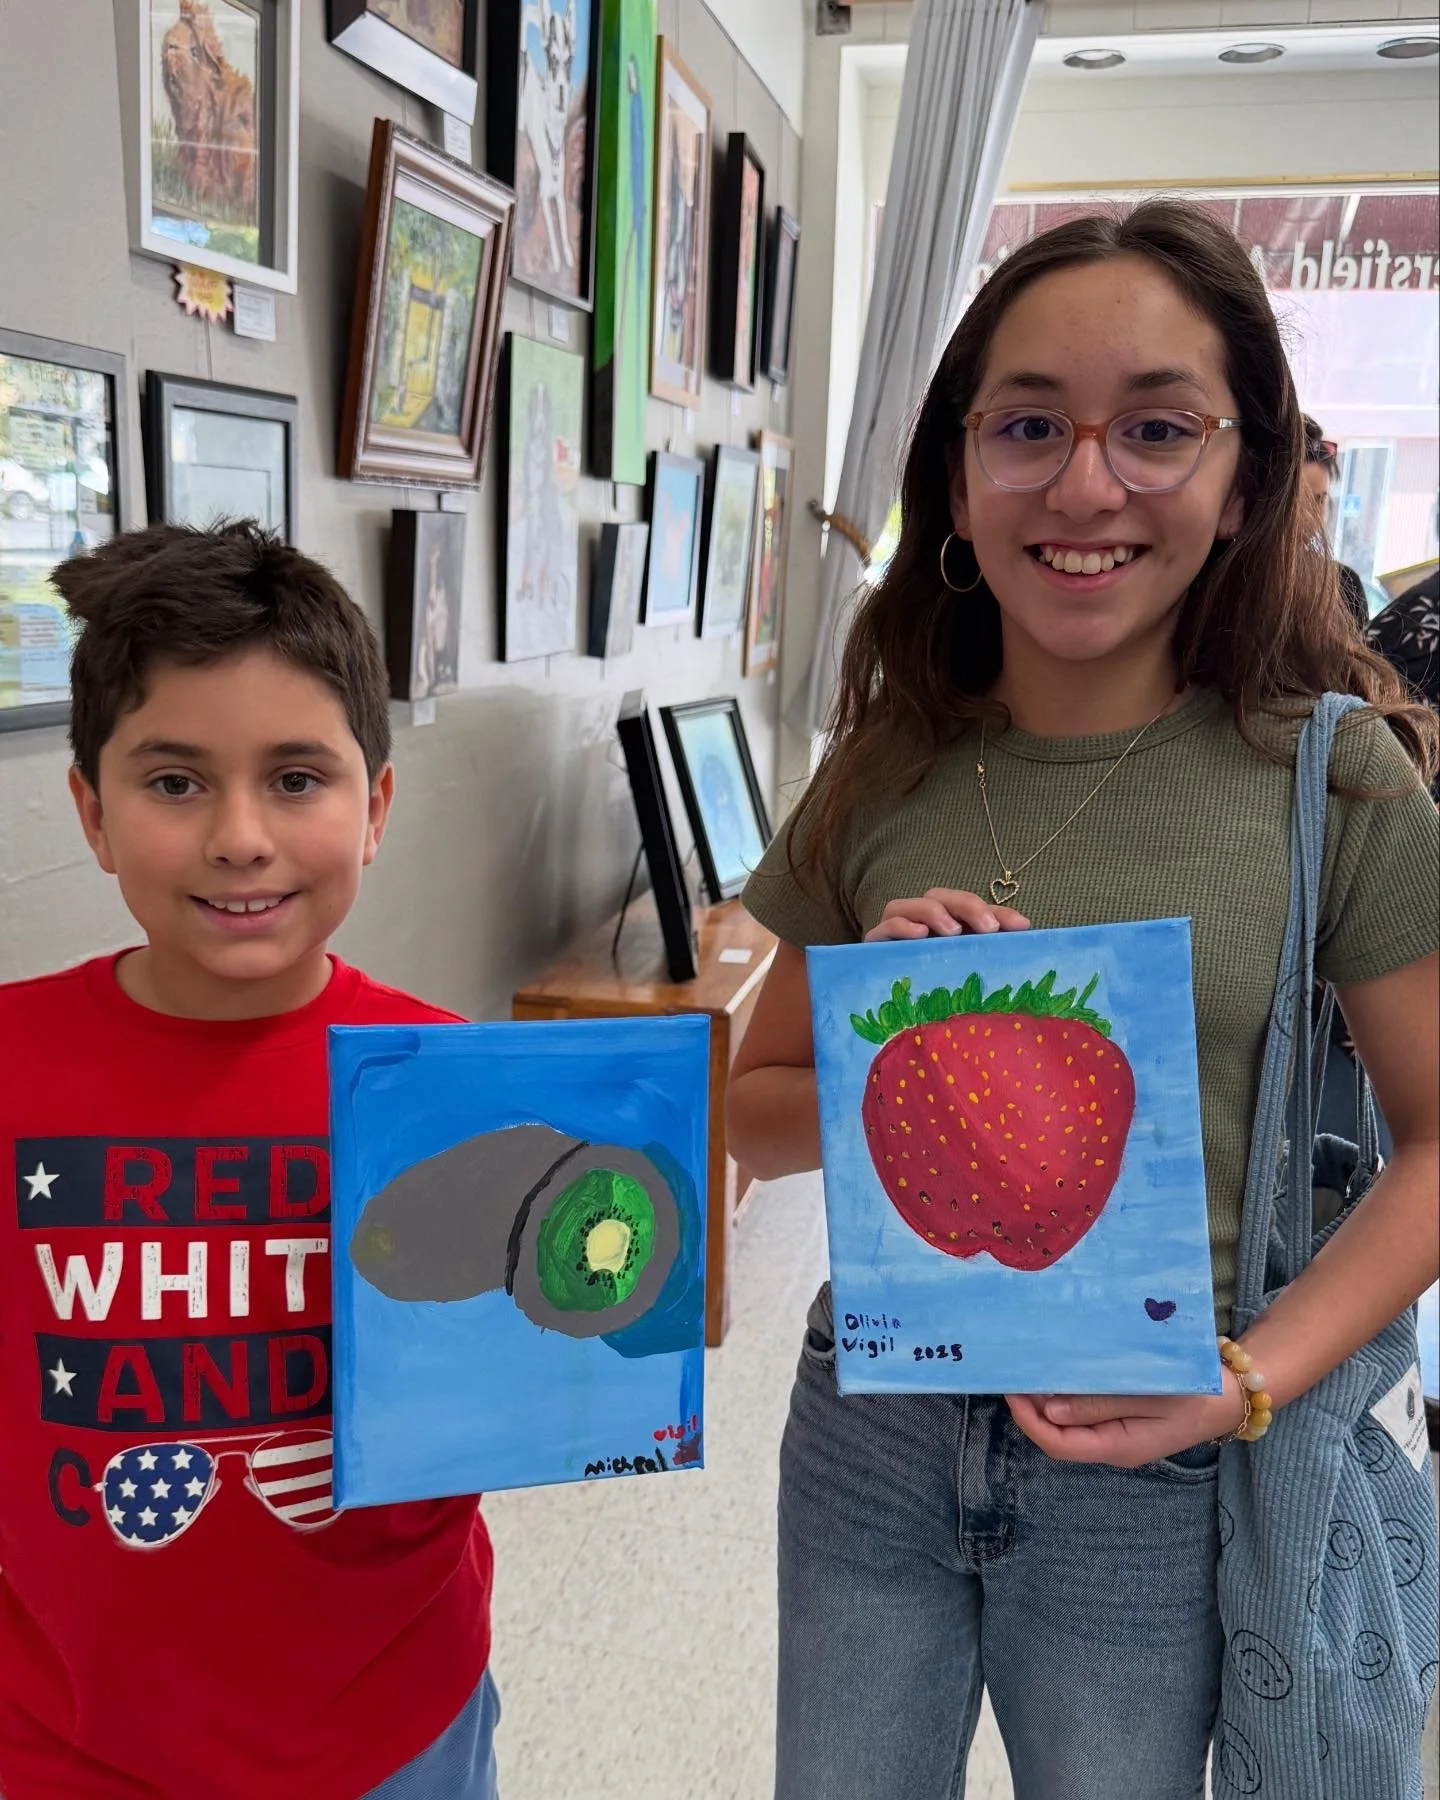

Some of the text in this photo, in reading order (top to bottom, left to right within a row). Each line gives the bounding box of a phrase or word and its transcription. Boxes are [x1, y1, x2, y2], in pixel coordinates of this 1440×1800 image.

[104, 1144, 330, 1221] RED
[34, 1237, 329, 1322] WHIT
[841, 1335, 963, 1362] Vigil 2025
[844, 1313, 902, 1330] Olivia
[96, 1333, 329, 1424] AND
